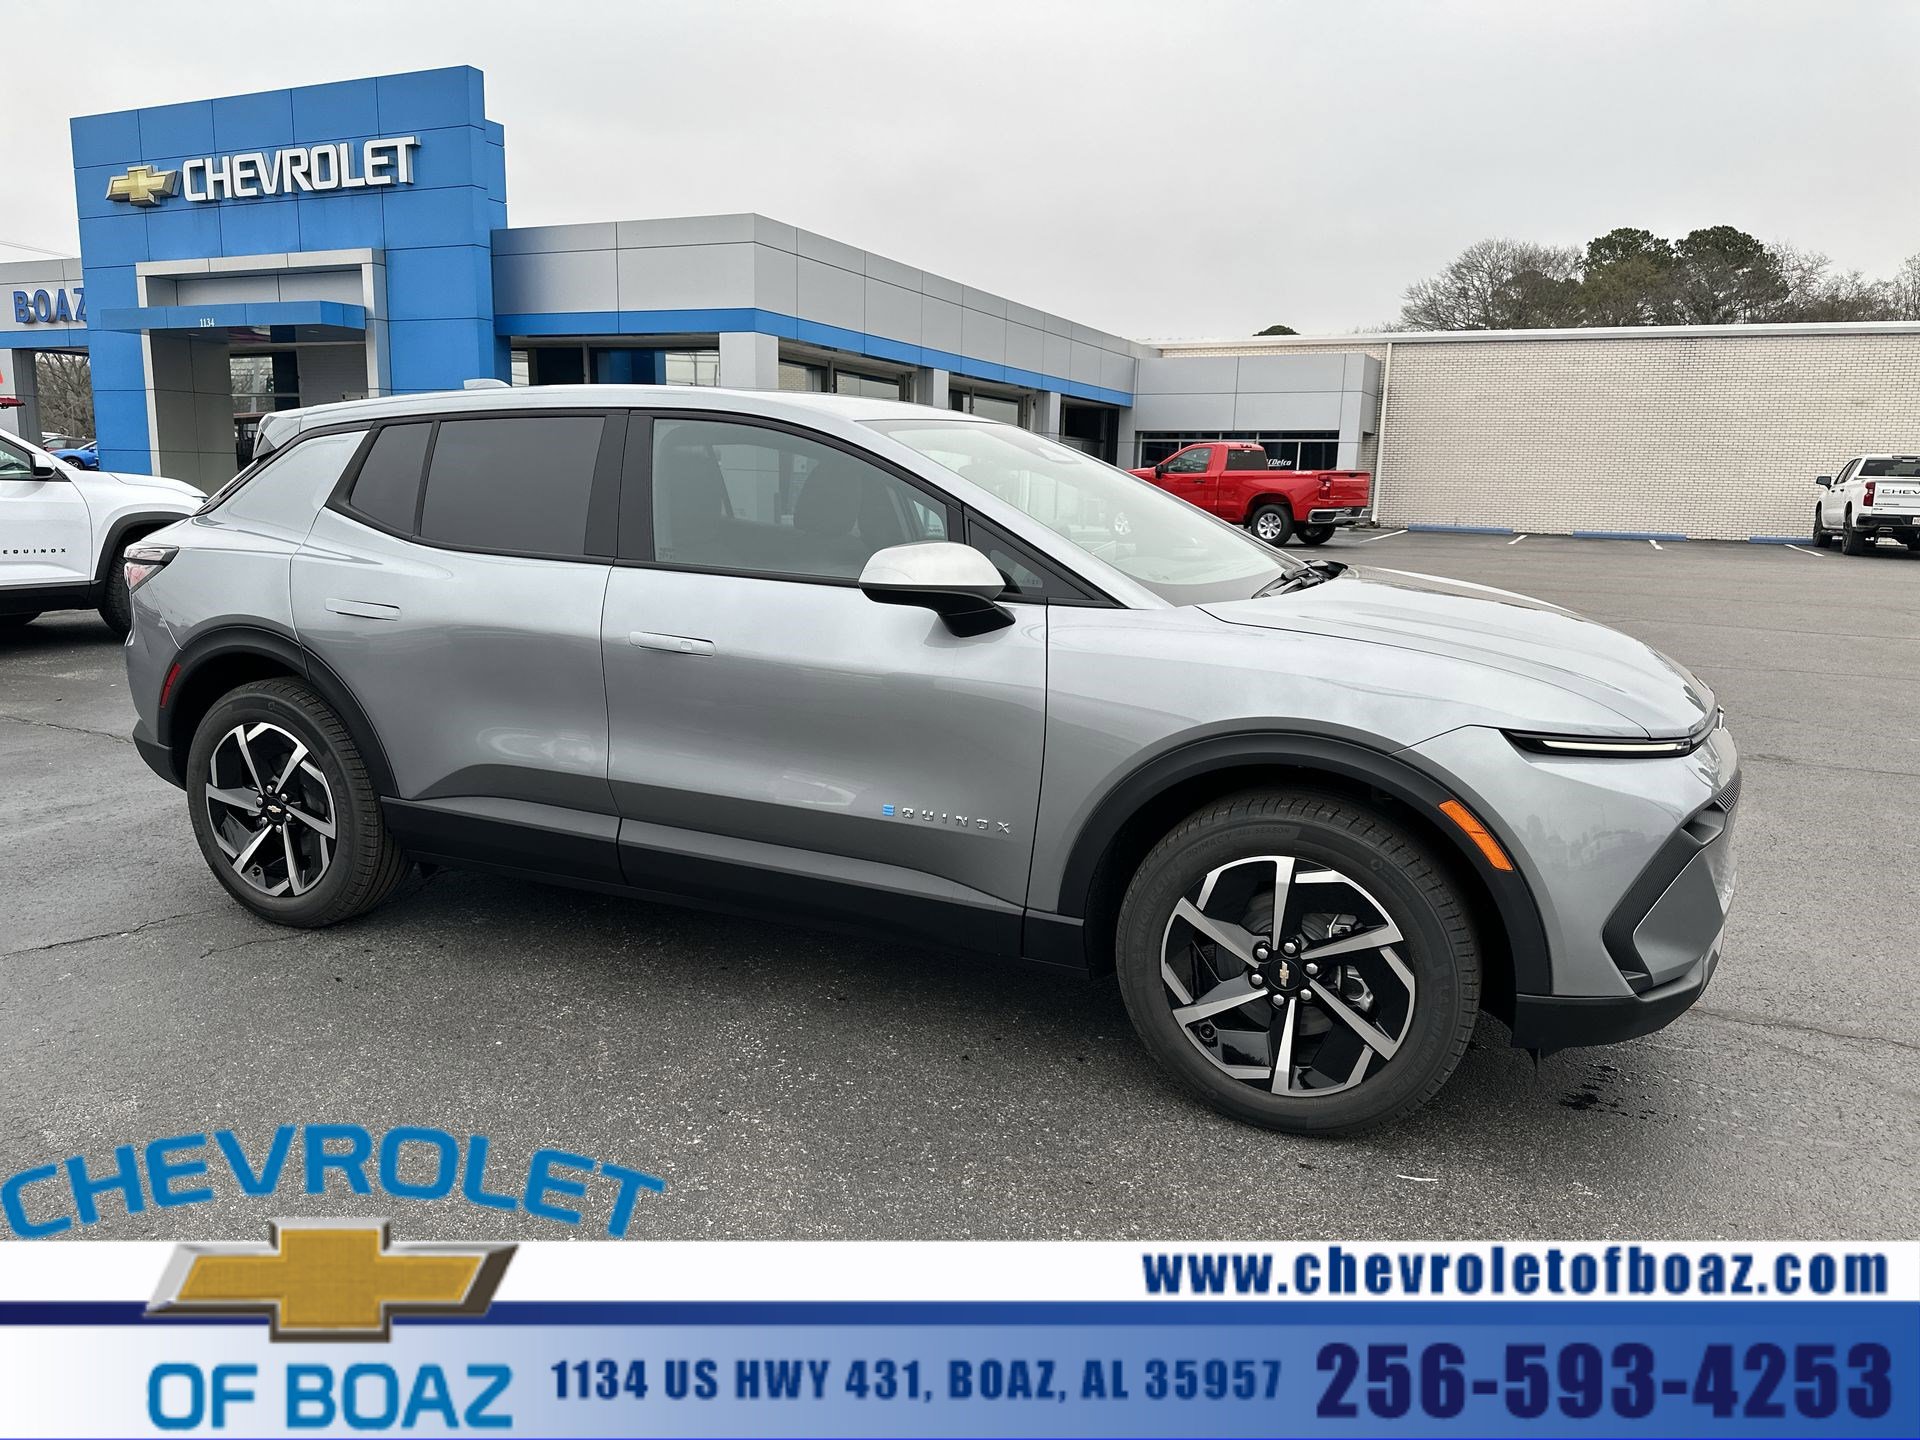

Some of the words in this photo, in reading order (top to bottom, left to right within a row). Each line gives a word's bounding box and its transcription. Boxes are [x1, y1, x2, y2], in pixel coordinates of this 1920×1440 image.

[183, 136, 420, 202] CHEVROLET
[13, 288, 87, 323] BOAZ
[199, 318, 215, 328] 1134
[1266, 458, 1292, 466] CDelco
[882, 804, 1011, 834] EQUINOX
